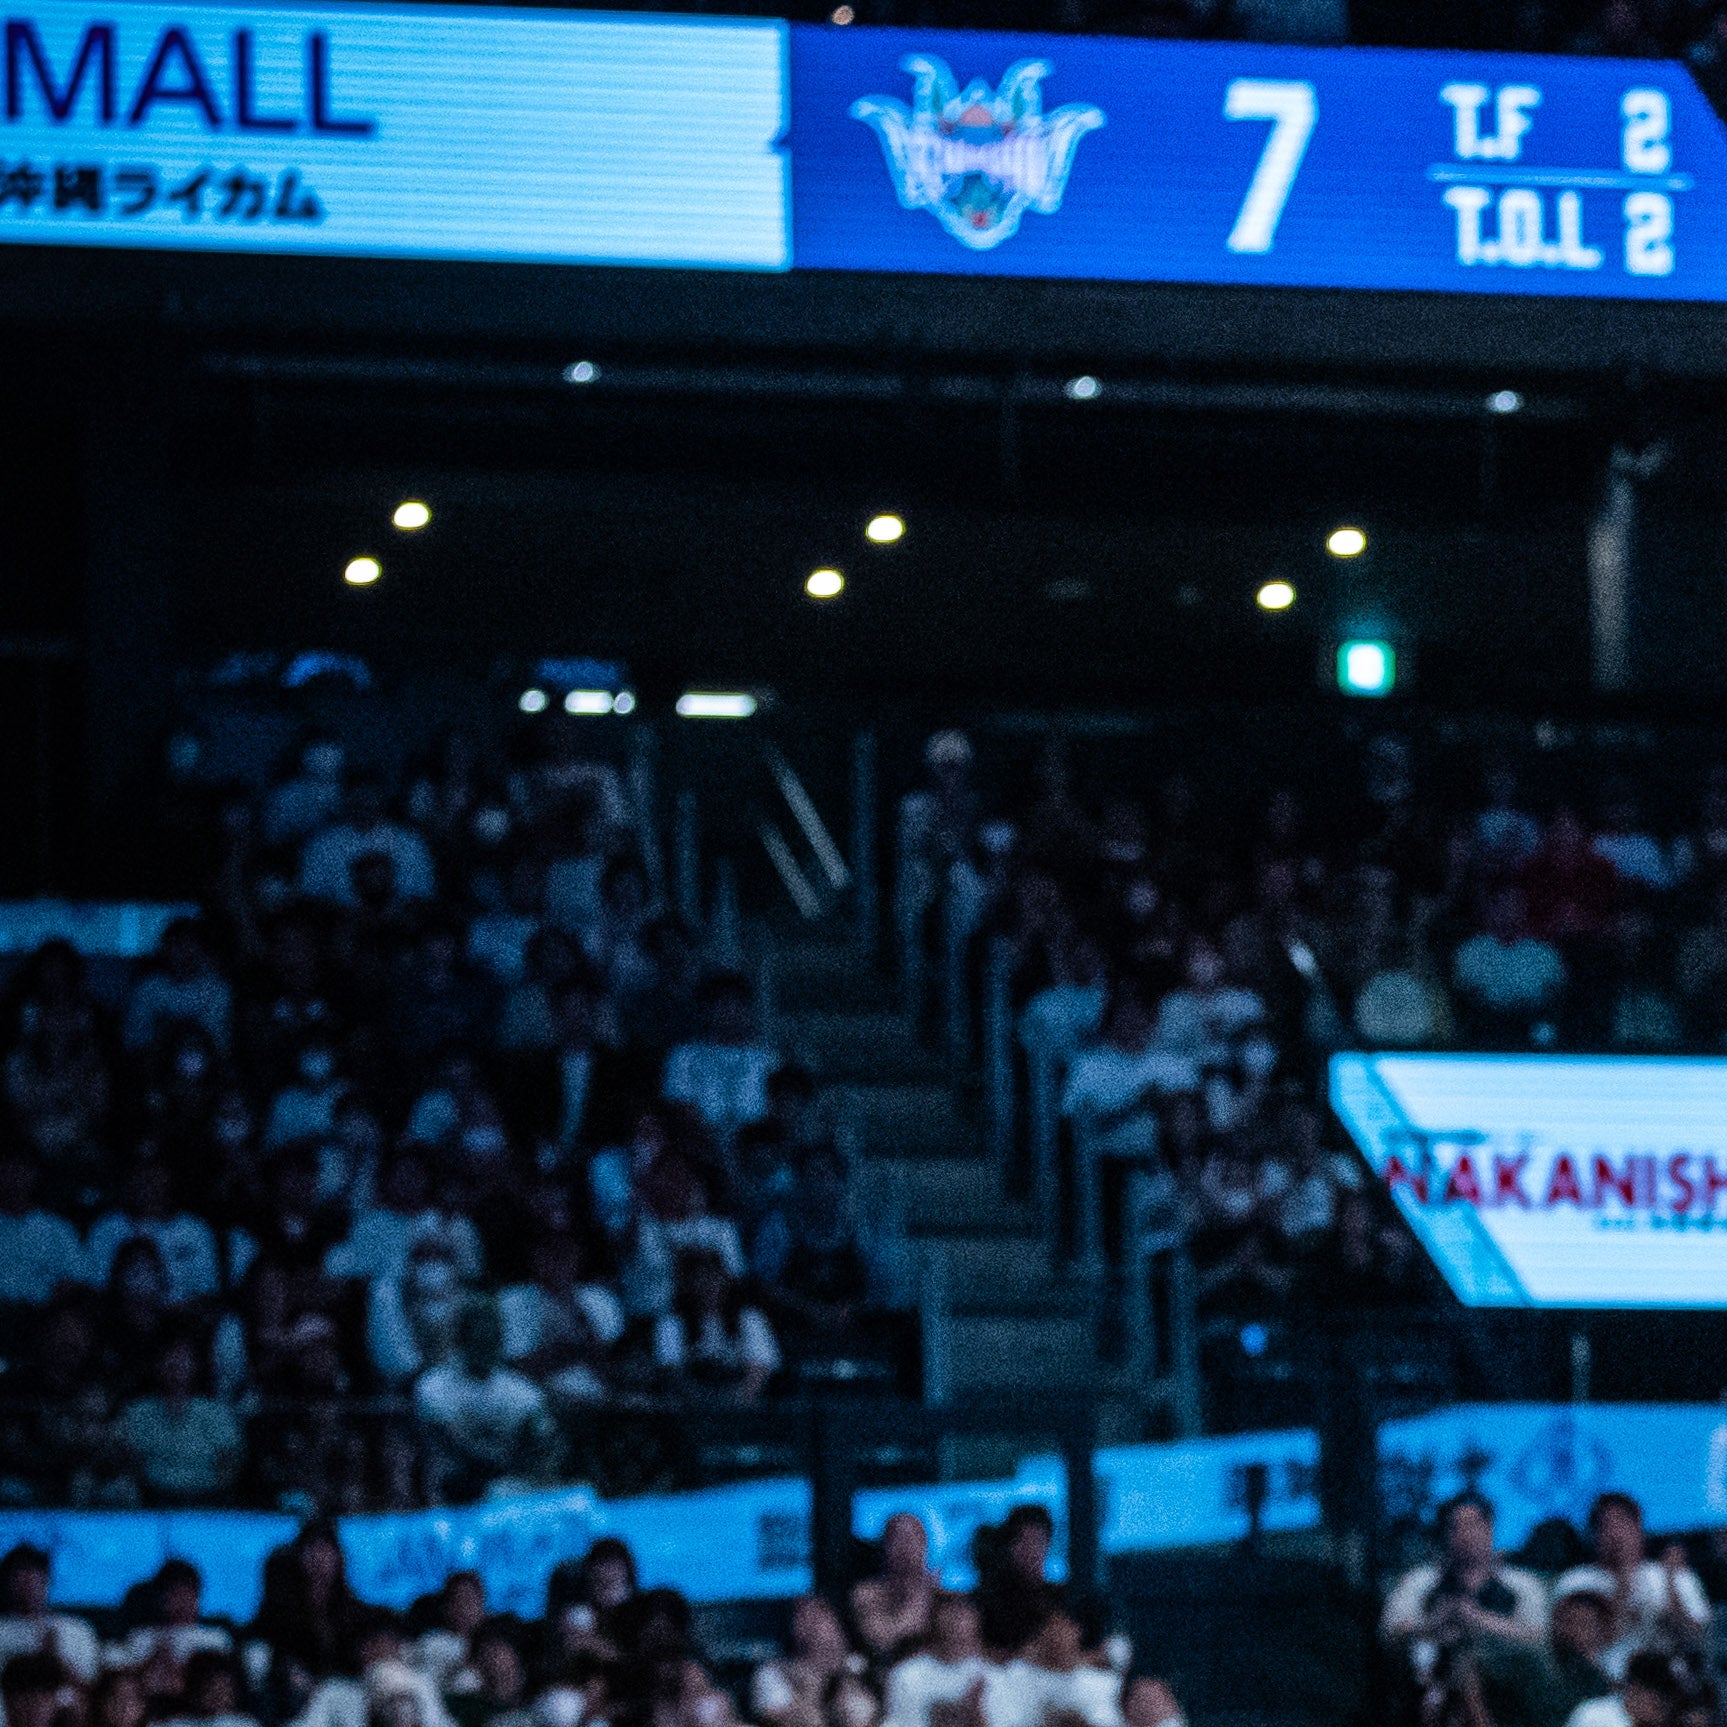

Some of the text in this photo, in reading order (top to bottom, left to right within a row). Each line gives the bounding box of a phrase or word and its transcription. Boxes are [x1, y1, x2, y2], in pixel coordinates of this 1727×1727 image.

[4, 20, 378, 138] MALL
[1620, 86, 1673, 176] 2
[1223, 78, 1318, 255] 7
[1622, 189, 1676, 278] 2
